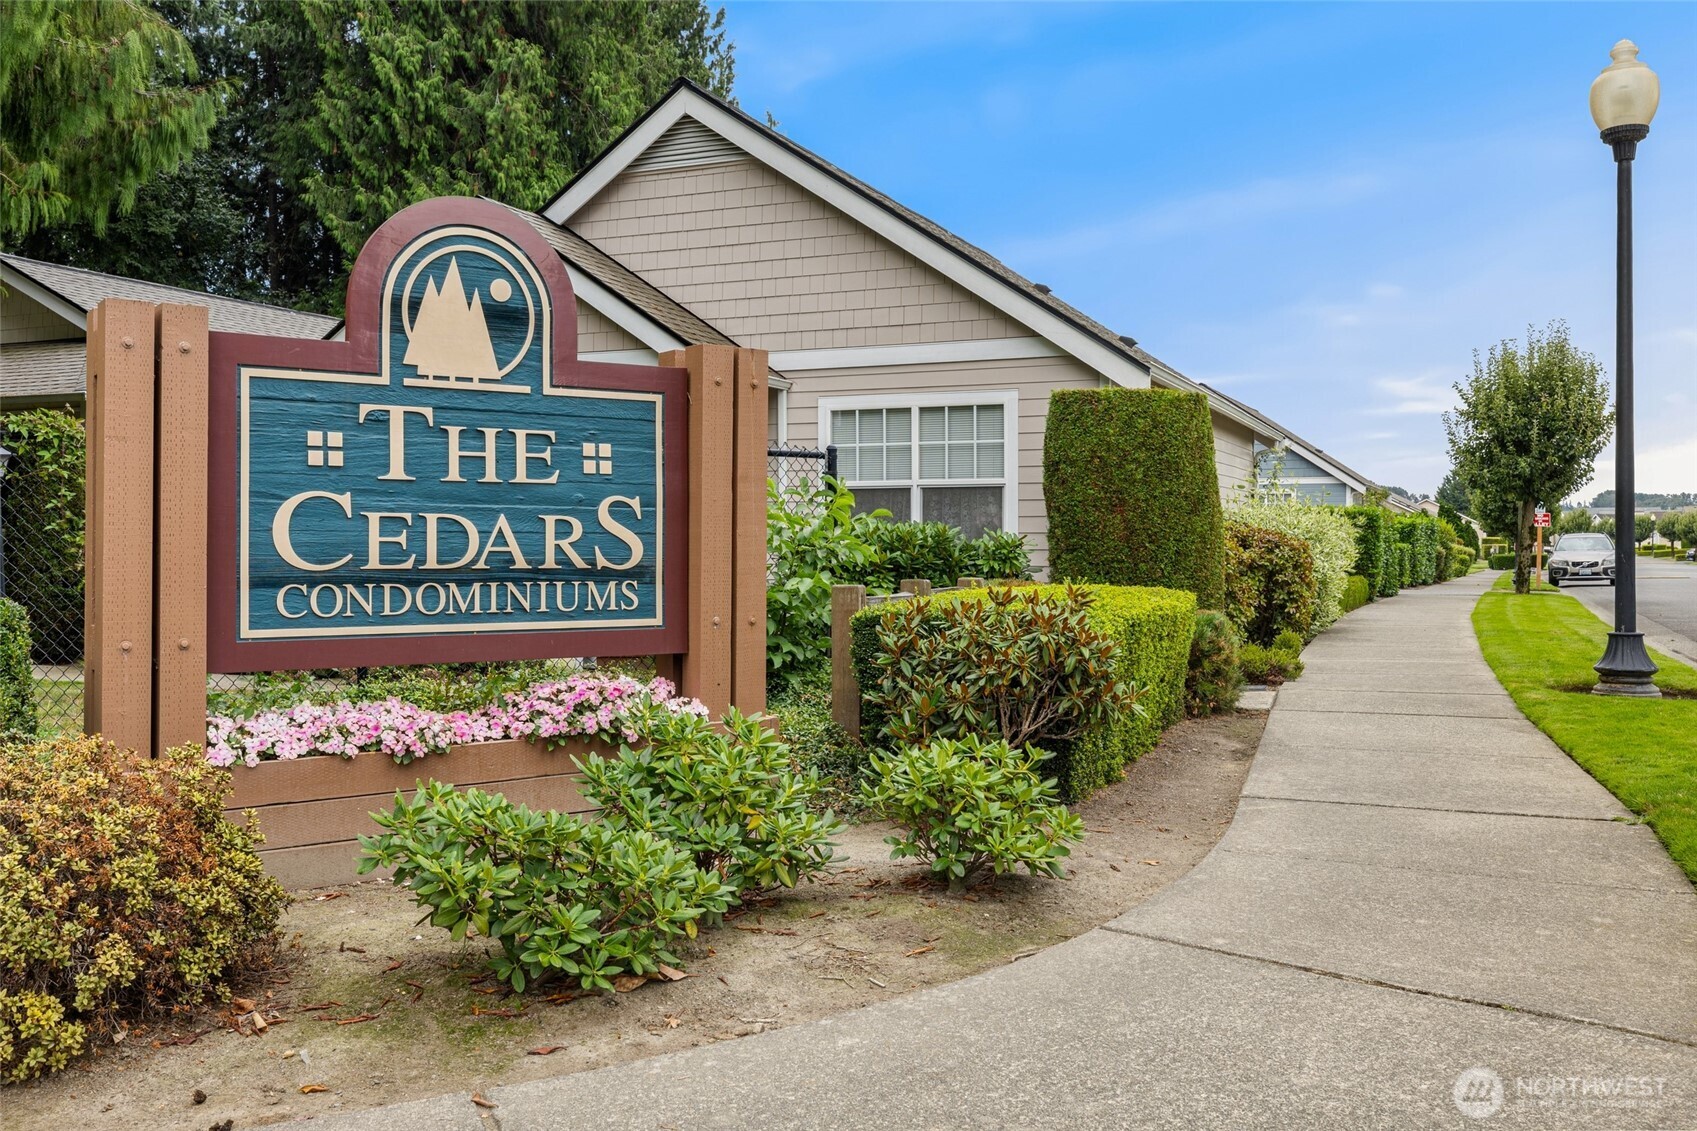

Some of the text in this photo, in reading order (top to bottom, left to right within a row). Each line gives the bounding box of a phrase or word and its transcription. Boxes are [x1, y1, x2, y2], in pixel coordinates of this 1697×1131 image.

[359, 404, 560, 483] THE
[272, 491, 644, 571] CEDARS
[276, 581, 639, 618] CONDOMINIUMS
